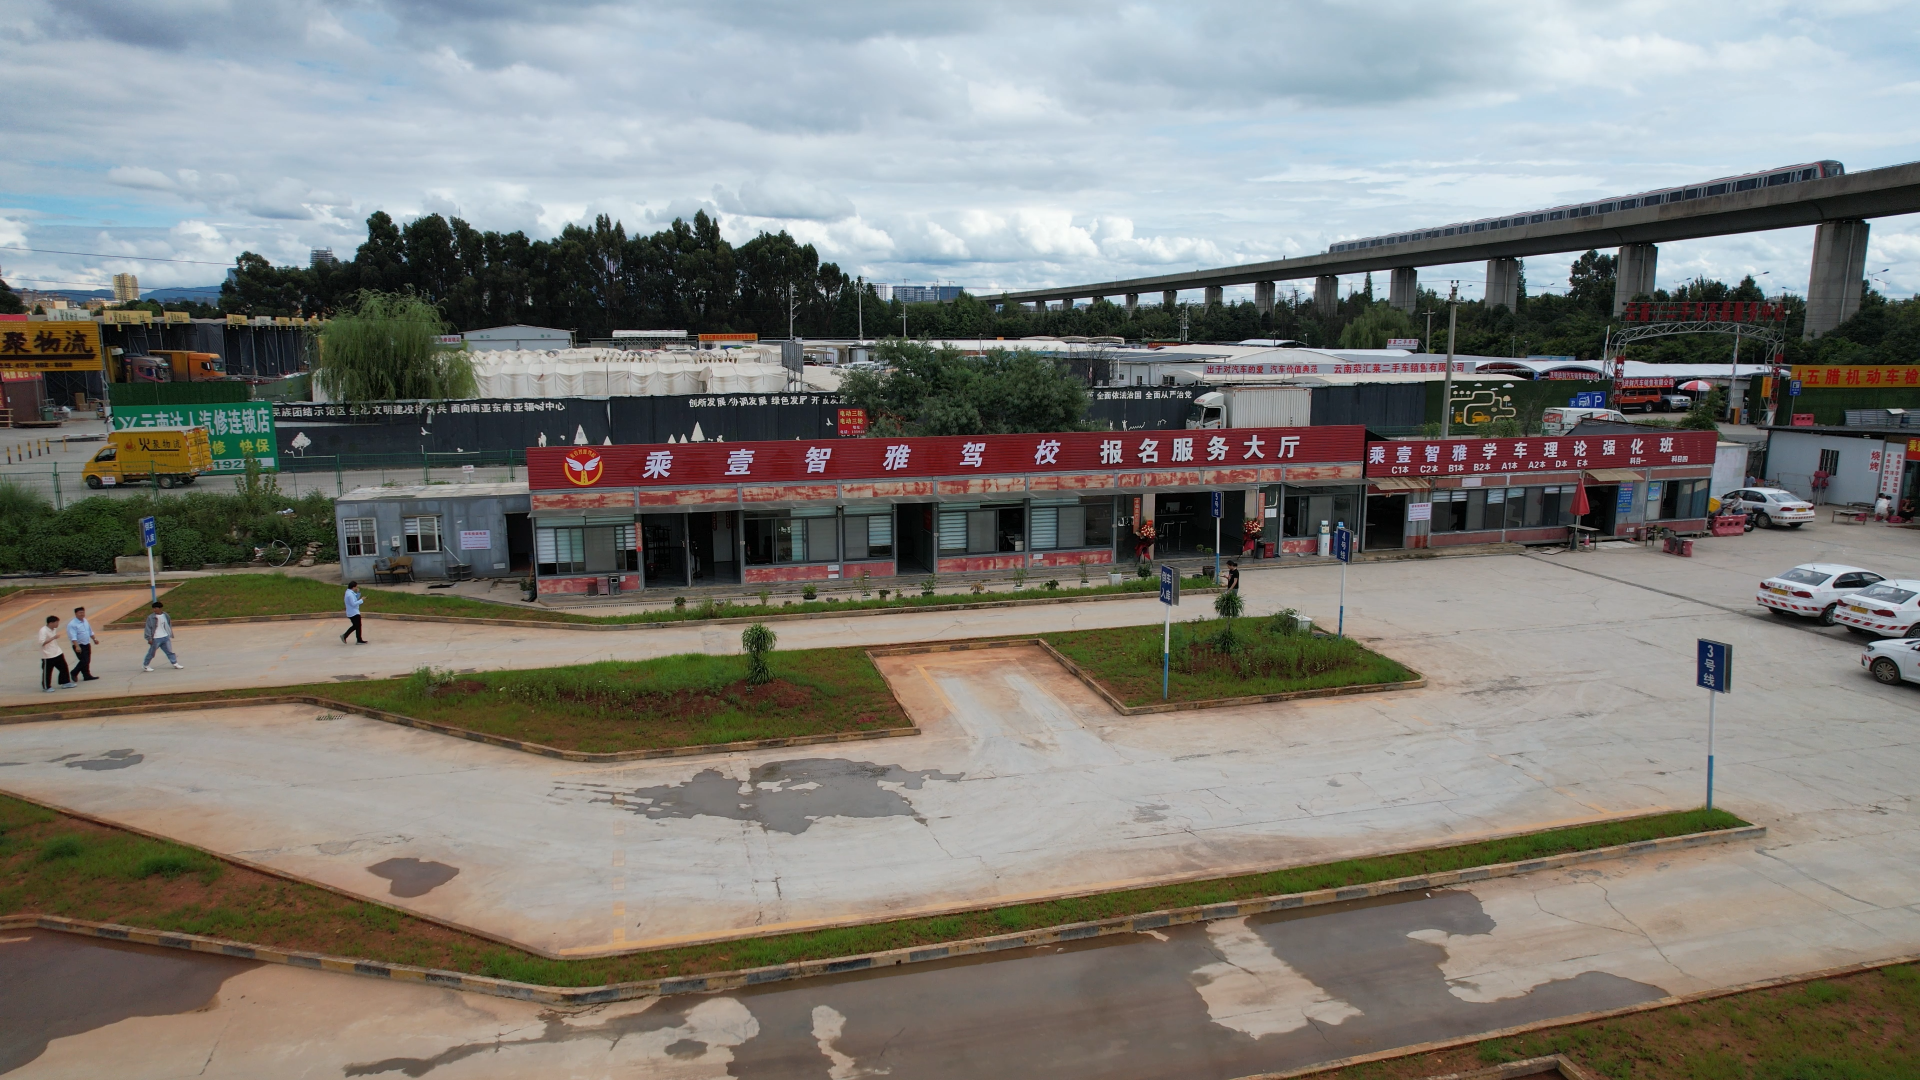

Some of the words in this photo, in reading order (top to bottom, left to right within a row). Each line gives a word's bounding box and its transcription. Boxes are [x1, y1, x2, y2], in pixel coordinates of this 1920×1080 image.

[1625, 302, 1786, 322] 云南二手车交易服务中心
[1, 330, 94, 354] 聚物流
[1206, 365, 1264, 374] 出于对汽车的爱
[1270, 364, 1318, 374] 汽车价值典范
[1334, 362, 1465, 374] 云南荣汇莱二手车销售有限司
[1096, 390, 1142, 400] 全面依法治国
[1145, 390, 1192, 400] 全面从严治党
[140, 407, 271, 436] 云南达人汽修连锁店
[240, 438, 271, 454] 快保
[1368, 436, 1674, 465] 乘壹智雅学车理论强化班
[642, 439, 1062, 479] 乘壹智雅驾校
[1100, 434, 1301, 465] 报名服务大厅
[1391, 466, 1409, 474] C1本
[1420, 465, 1438, 473] C2本
[1448, 464, 1464, 472] B1本
[1474, 463, 1491, 471] B2本
[1501, 462, 1518, 470] A1本
[1528, 461, 1546, 469] A2本
[1576, 459, 1588, 467] E本
[1869, 450, 1881, 472] 烧烤
[1162, 571, 1172, 584] 倒车
[1161, 588, 1171, 601] 入库
[1704, 644, 1716, 687] 3号线
